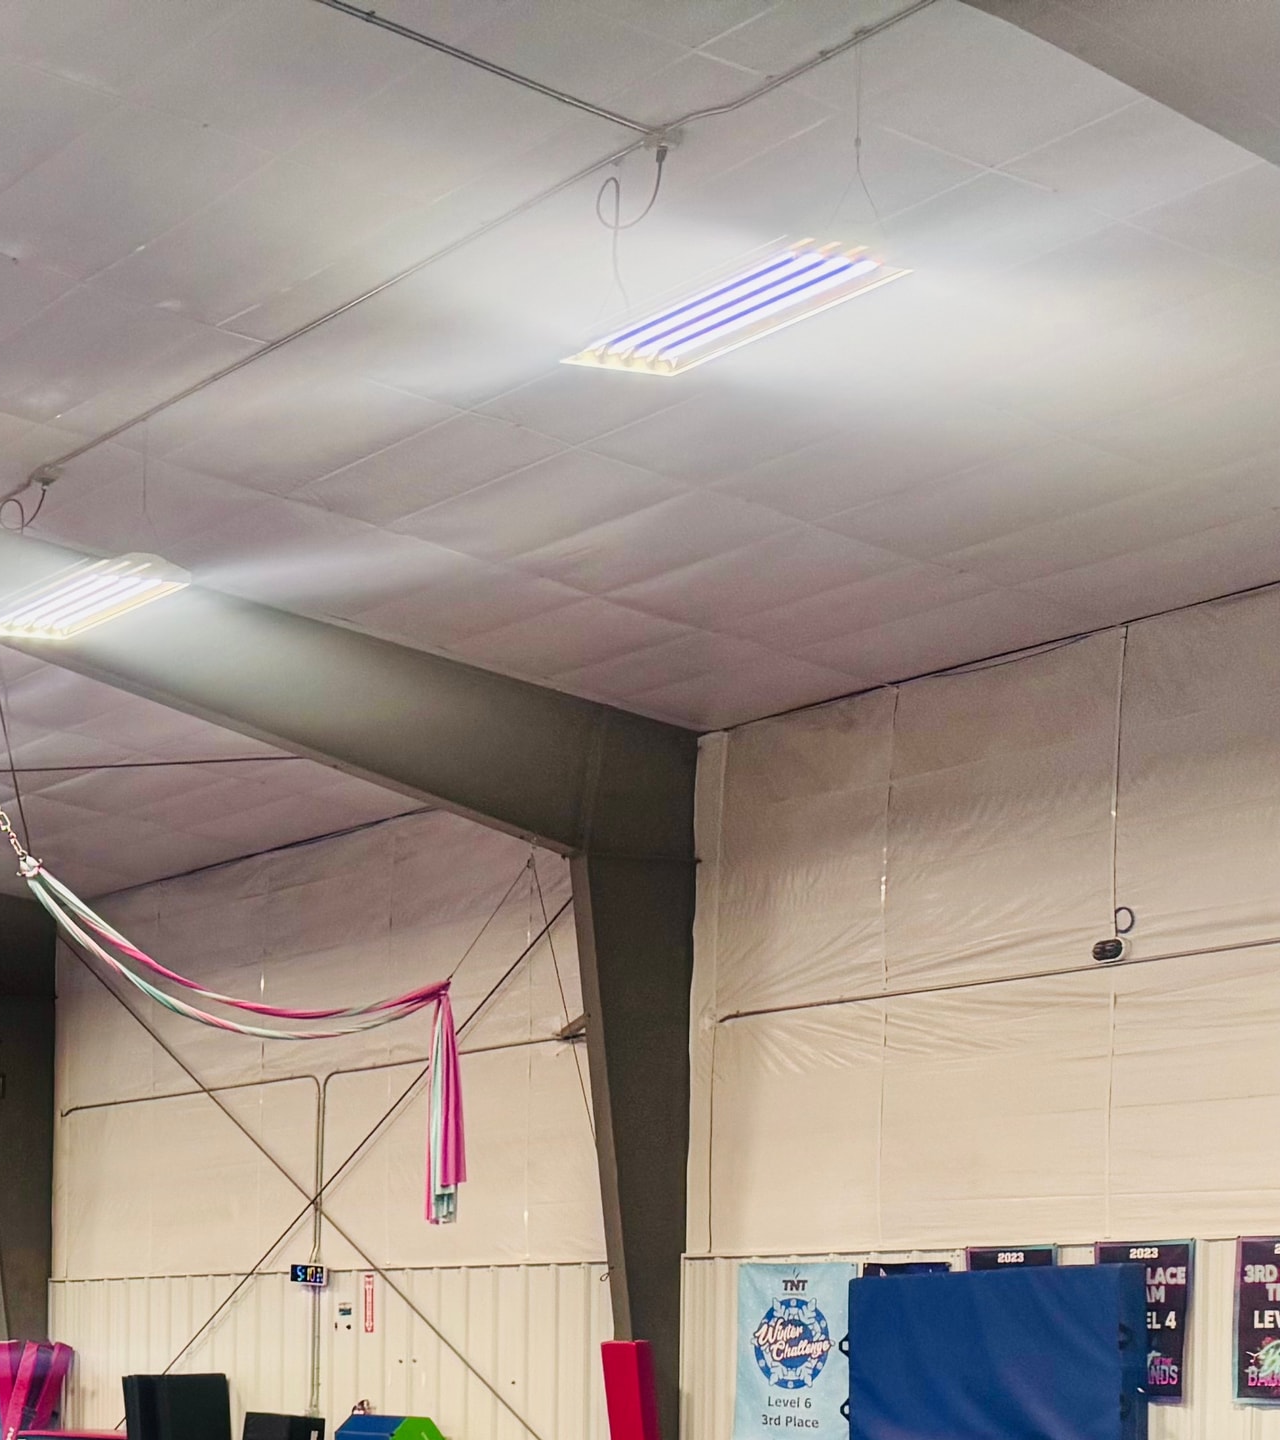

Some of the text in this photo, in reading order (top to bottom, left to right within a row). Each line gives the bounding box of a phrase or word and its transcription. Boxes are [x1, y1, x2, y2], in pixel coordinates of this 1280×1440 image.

[997, 1252, 1024, 1264] 2023
[1129, 1247, 1159, 1259] 2023
[1146, 1266, 1187, 1285] LACE
[1243, 1264, 1278, 1283] 3RD
[782, 1279, 808, 1292] TNT
[1164, 1310, 1177, 1330] 4
[754, 1317, 804, 1345] Winter
[769, 1339, 831, 1361] Challenge
[767, 1395, 812, 1409] Level 6
[761, 1413, 820, 1429] 3rd Place
